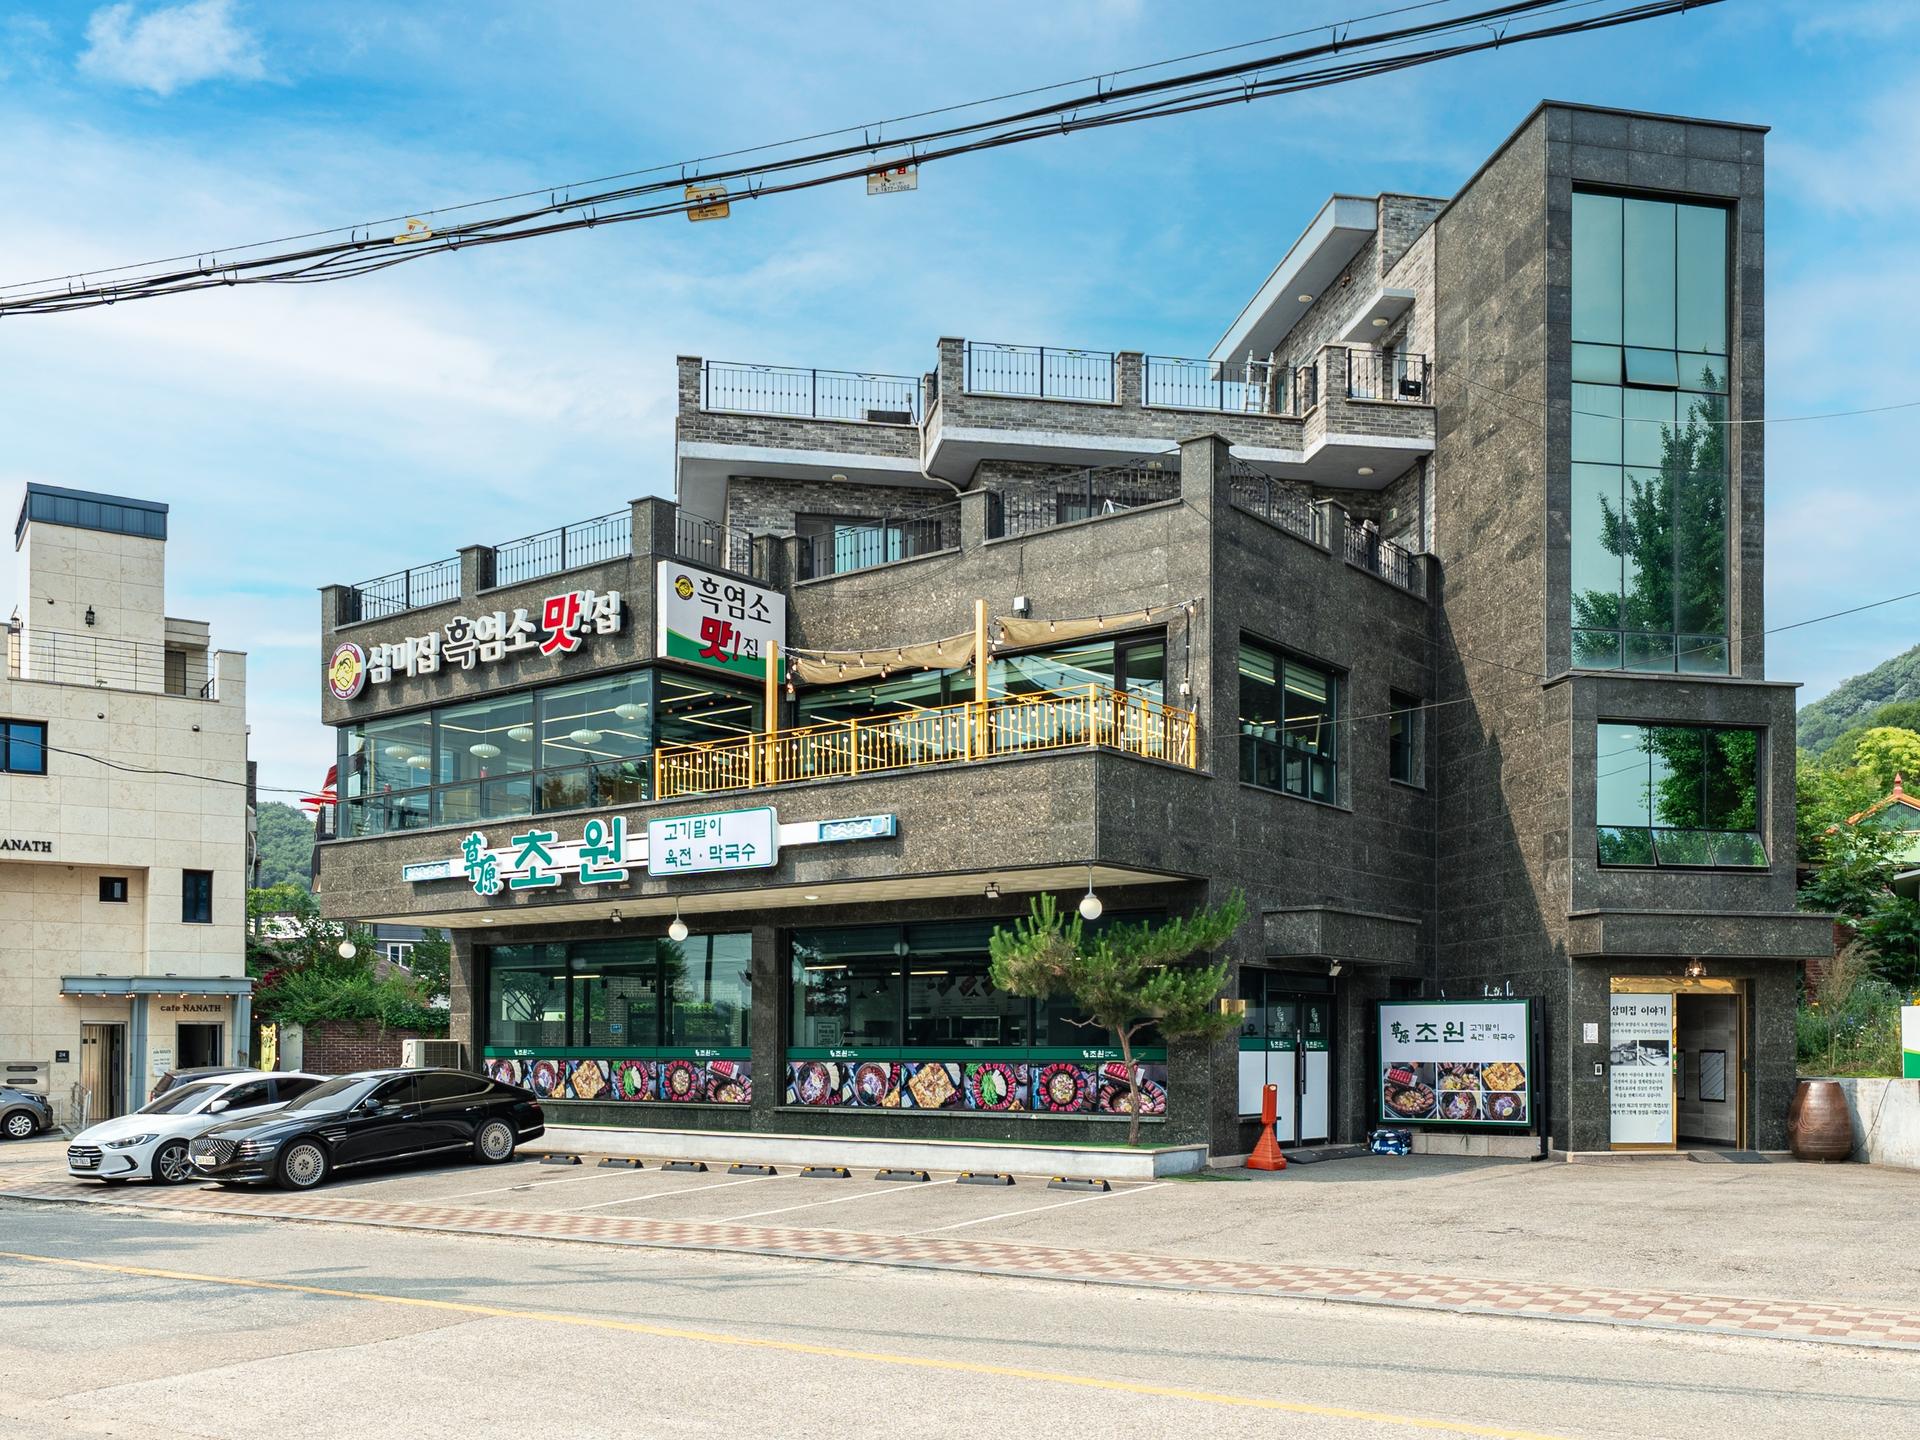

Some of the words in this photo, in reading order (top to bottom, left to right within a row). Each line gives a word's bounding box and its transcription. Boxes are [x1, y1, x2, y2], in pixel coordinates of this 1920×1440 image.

[697, 577, 771, 624] 흑염소
[366, 632, 441, 684] 삼미집
[442, 609, 539, 670] 흑염소
[698, 616, 758, 663] 맛!집
[663, 817, 723, 841] 고기말이
[461, 832, 502, 895] 草原
[510, 816, 628, 890] 초원
[664, 848, 692, 867] 육전
[709, 842, 756, 864] 막국수
[160, 1004, 181, 1012] cafe
[182, 1003, 222, 1013] NANATH
[1610, 1005, 1637, 1016] 삼미집
[1640, 1005, 1667, 1016] 이야기
[1415, 1021, 1465, 1043] 초원
[1469, 1023, 1500, 1032] 고기말이
